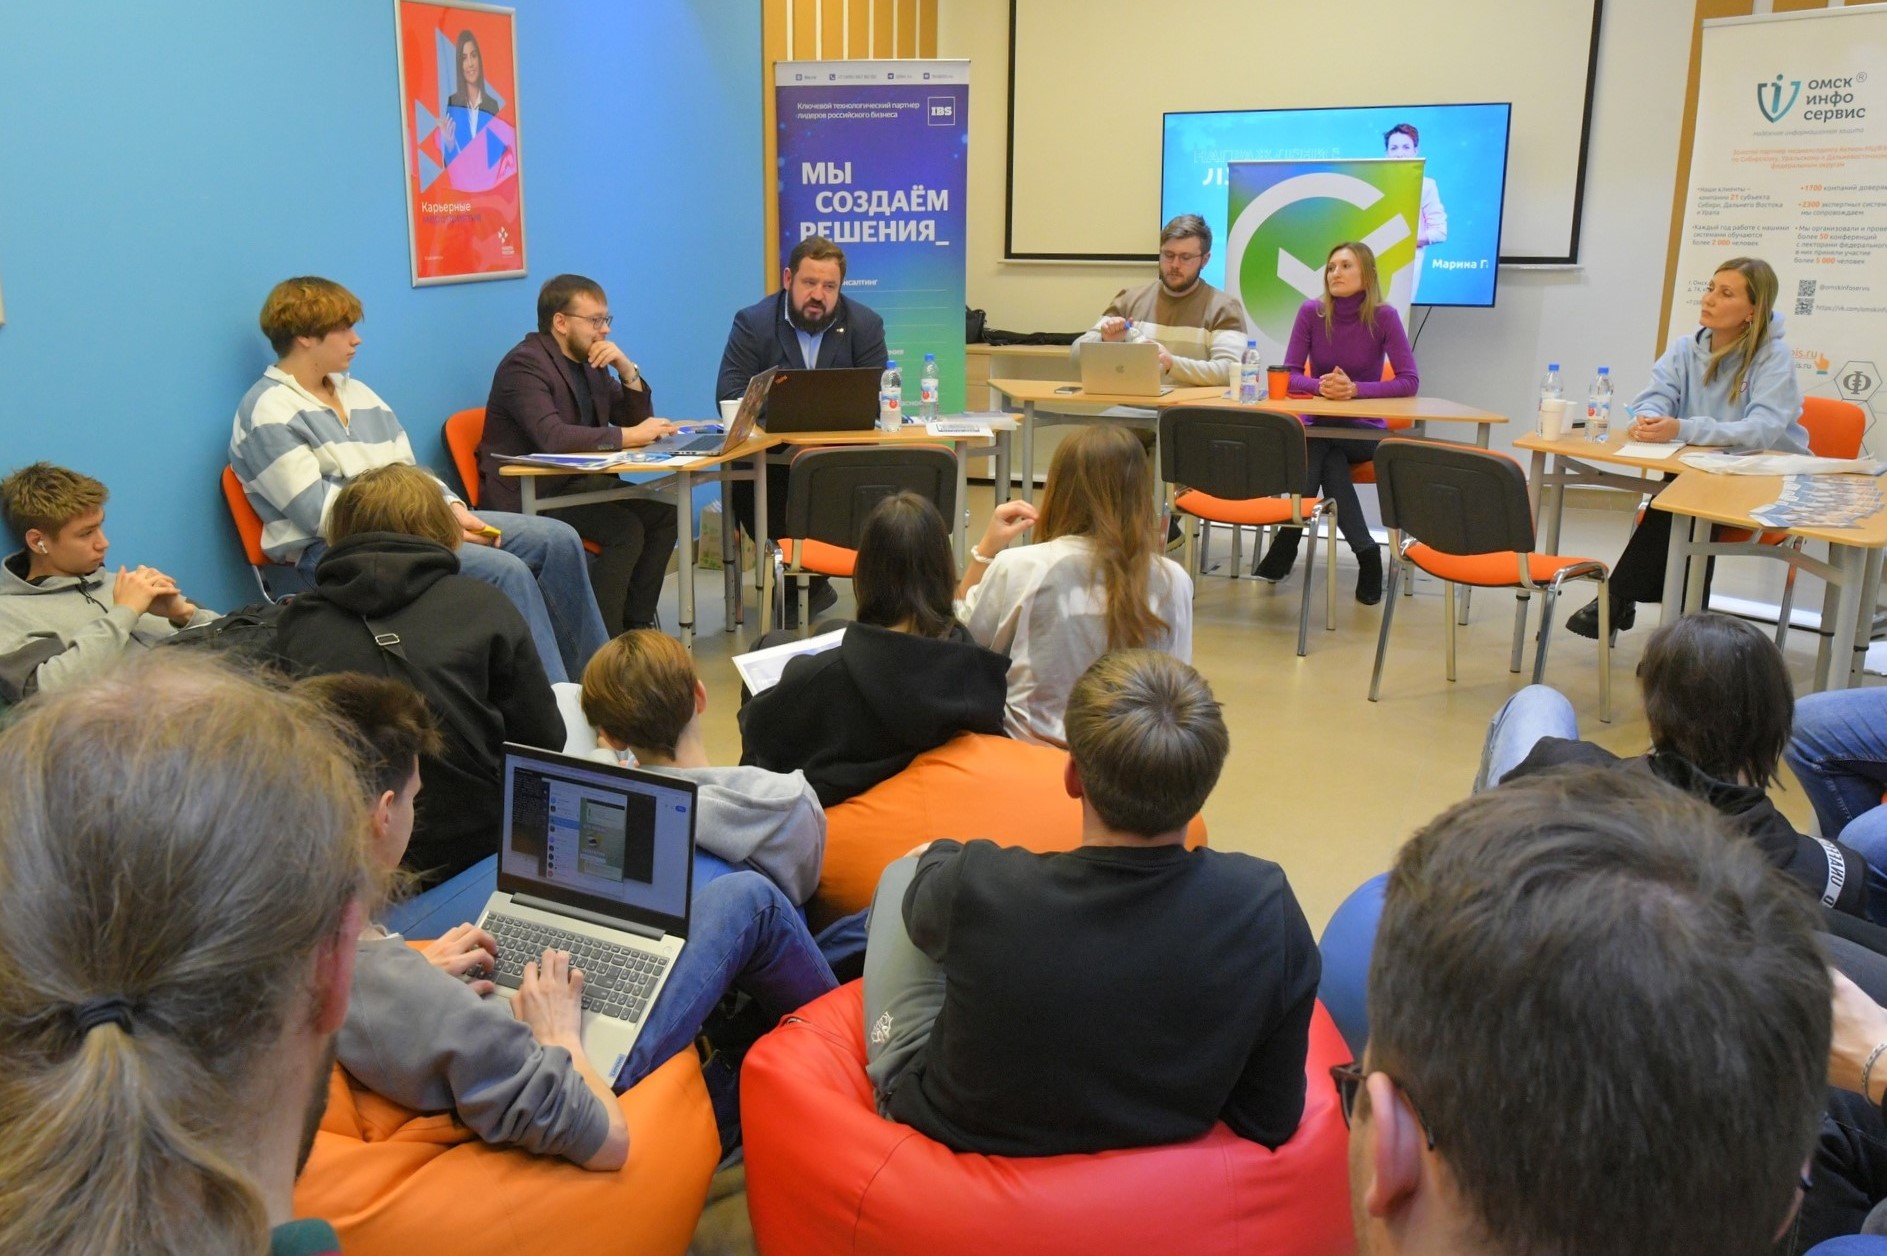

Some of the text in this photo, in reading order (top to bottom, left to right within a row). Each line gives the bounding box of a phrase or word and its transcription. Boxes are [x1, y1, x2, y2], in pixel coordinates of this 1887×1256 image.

[1808, 77, 1852, 90] омск
[1806, 90, 1854, 107] инфо
[797, 101, 921, 110] Ключевой технологический партнер
[931, 106, 952, 117] IBS
[828, 111, 871, 119] российского
[871, 111, 898, 119] бизнеса
[1804, 107, 1866, 123] сервис
[802, 162, 852, 185] МЫ
[815, 185, 949, 216] СОЗДАЁМ
[421, 201, 471, 214] Карьерные
[1432, 259, 1478, 271] Марина
